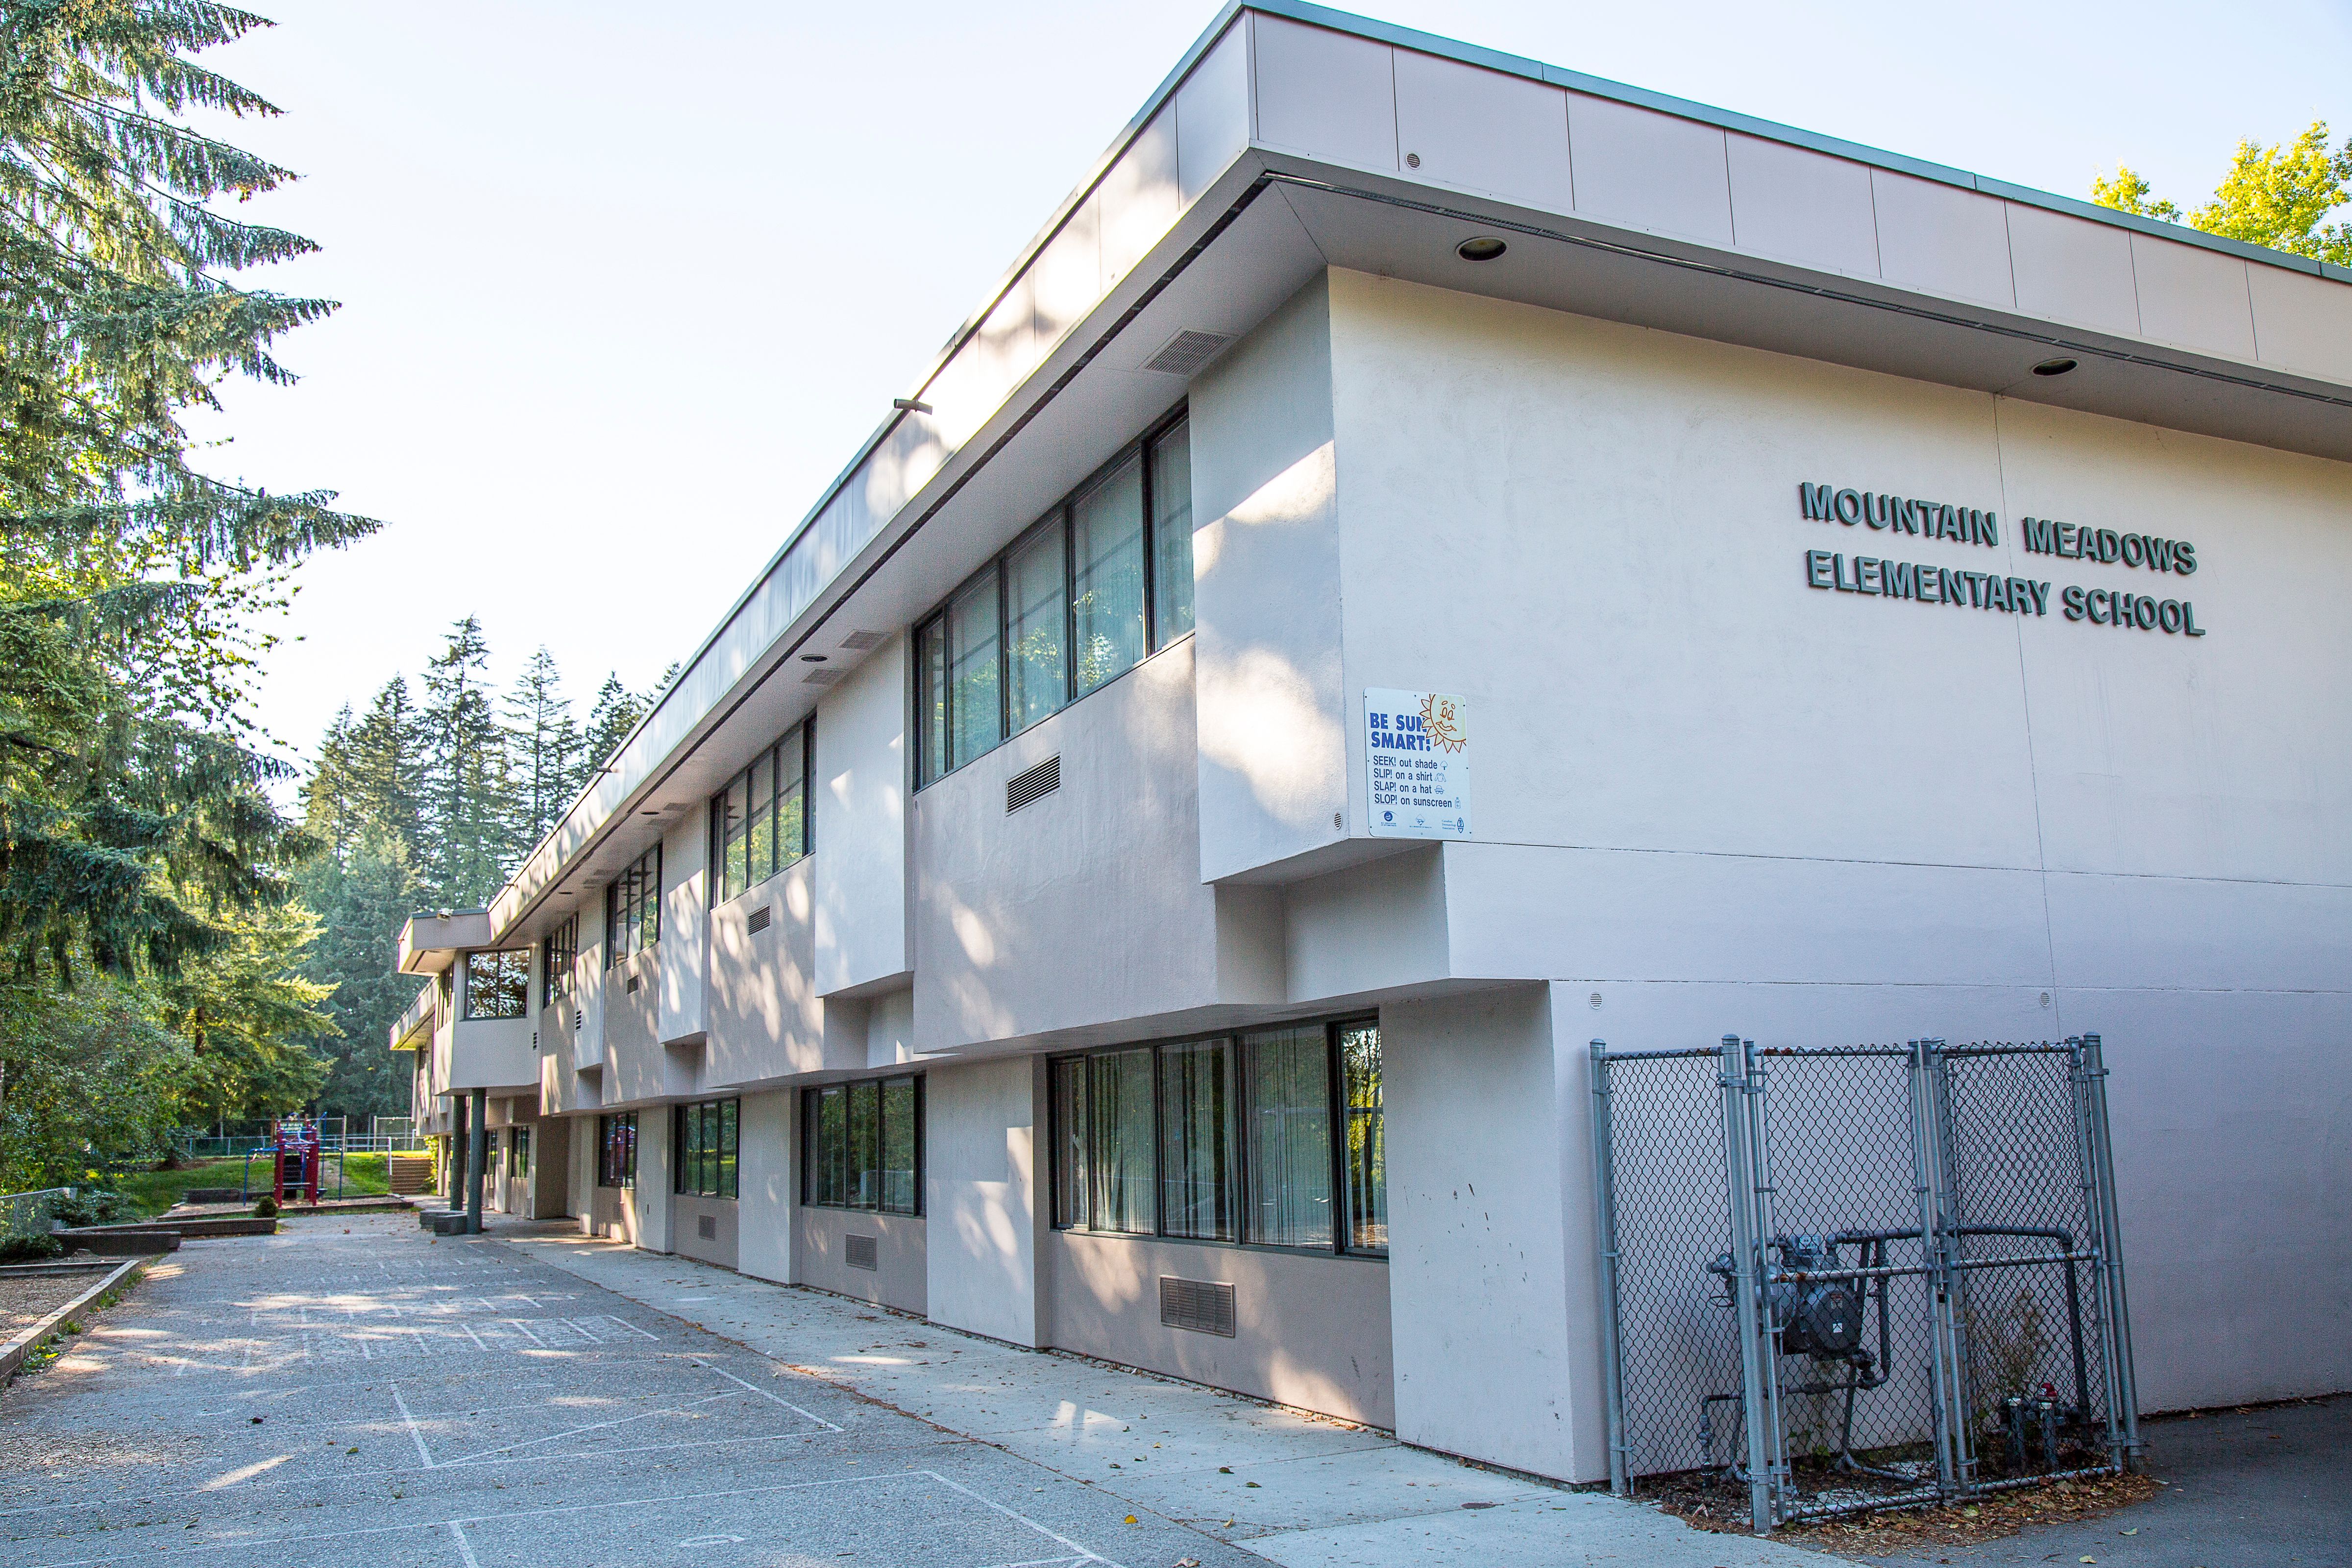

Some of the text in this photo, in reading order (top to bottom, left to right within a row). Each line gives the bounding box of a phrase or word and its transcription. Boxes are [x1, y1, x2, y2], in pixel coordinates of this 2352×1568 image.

[1800, 482, 2198, 575] MOUNTAIN MEADOWS
[1806, 550, 2206, 636] ELEMENTARY SCHOOL
[1370, 712, 1388, 730] BE
[1372, 731, 1431, 752] SMART!
[1373, 755, 1438, 769] SEEK! out shade
[1373, 768, 1392, 779] SLIP!
[1396, 771, 1405, 780] on
[1416, 771, 1432, 782] shirt
[1374, 781, 1396, 792] SLAP!
[1420, 784, 1432, 794] hat
[1374, 794, 1397, 805] SLOP!
[1400, 797, 1410, 805] on
[1413, 798, 1452, 808] sunscreen
